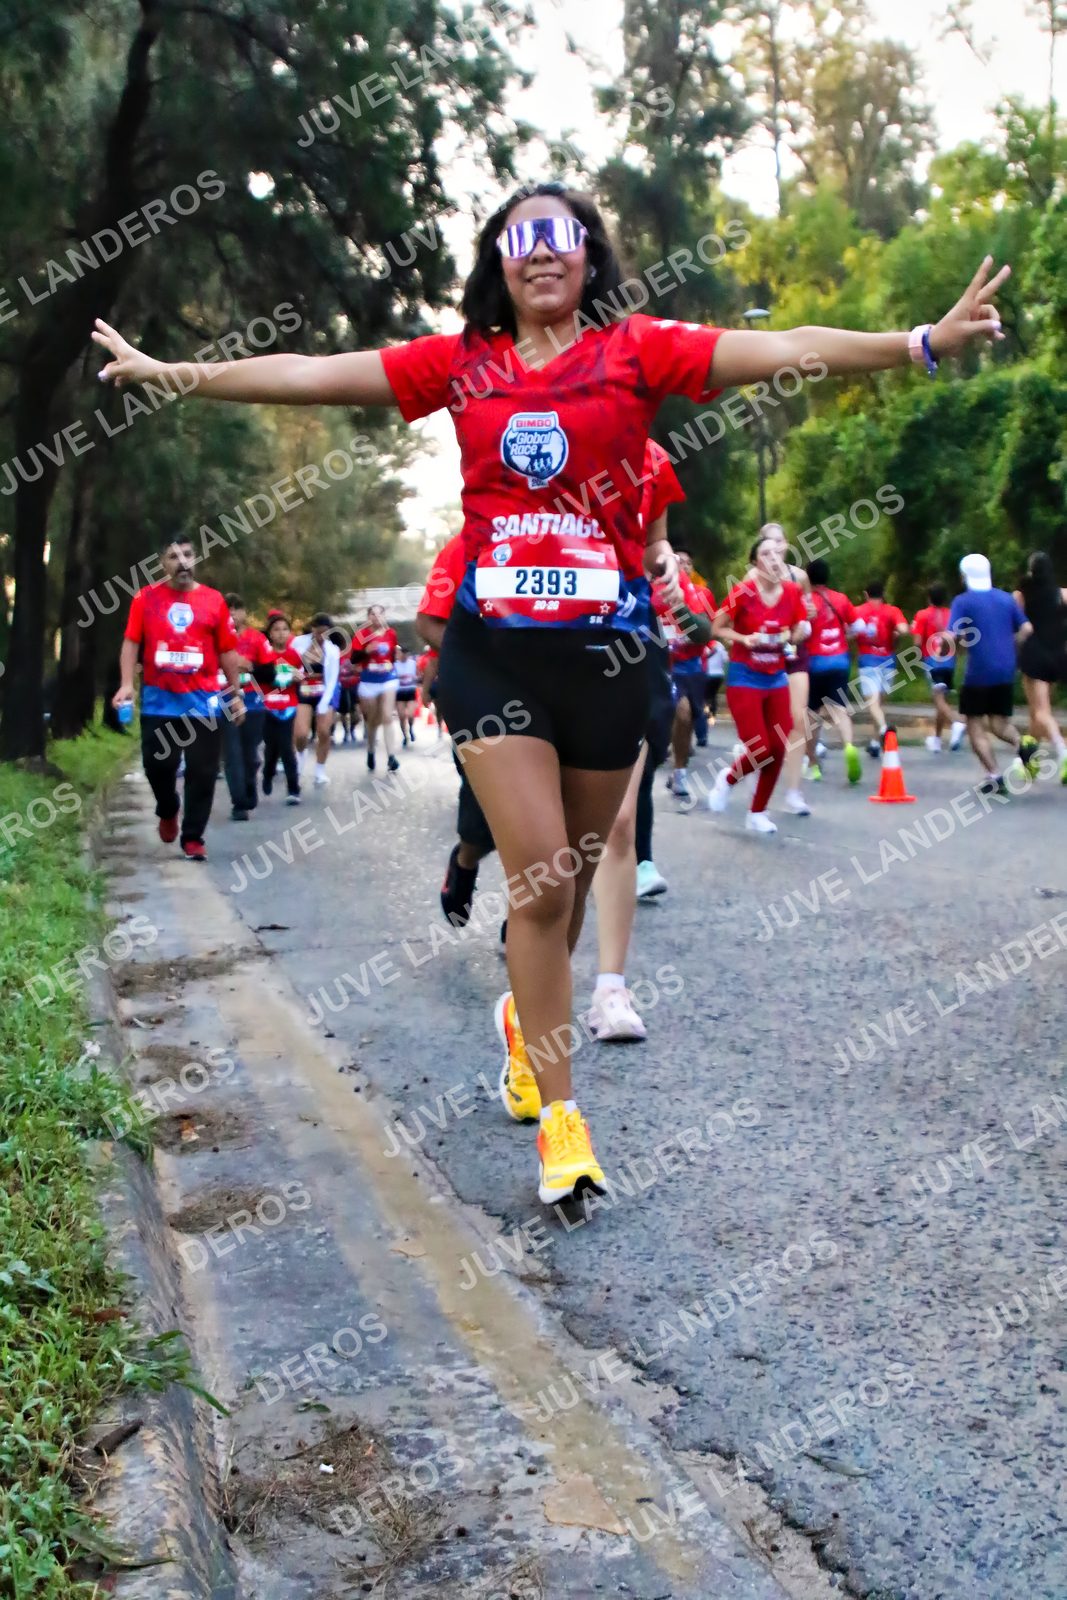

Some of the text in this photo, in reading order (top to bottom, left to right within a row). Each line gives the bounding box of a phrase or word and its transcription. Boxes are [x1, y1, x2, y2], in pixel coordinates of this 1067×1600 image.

[516, 419, 551, 427] BIMBO
[516, 431, 552, 444] Global
[510, 443, 538, 456] Race
[515, 569, 577, 595] 2393
